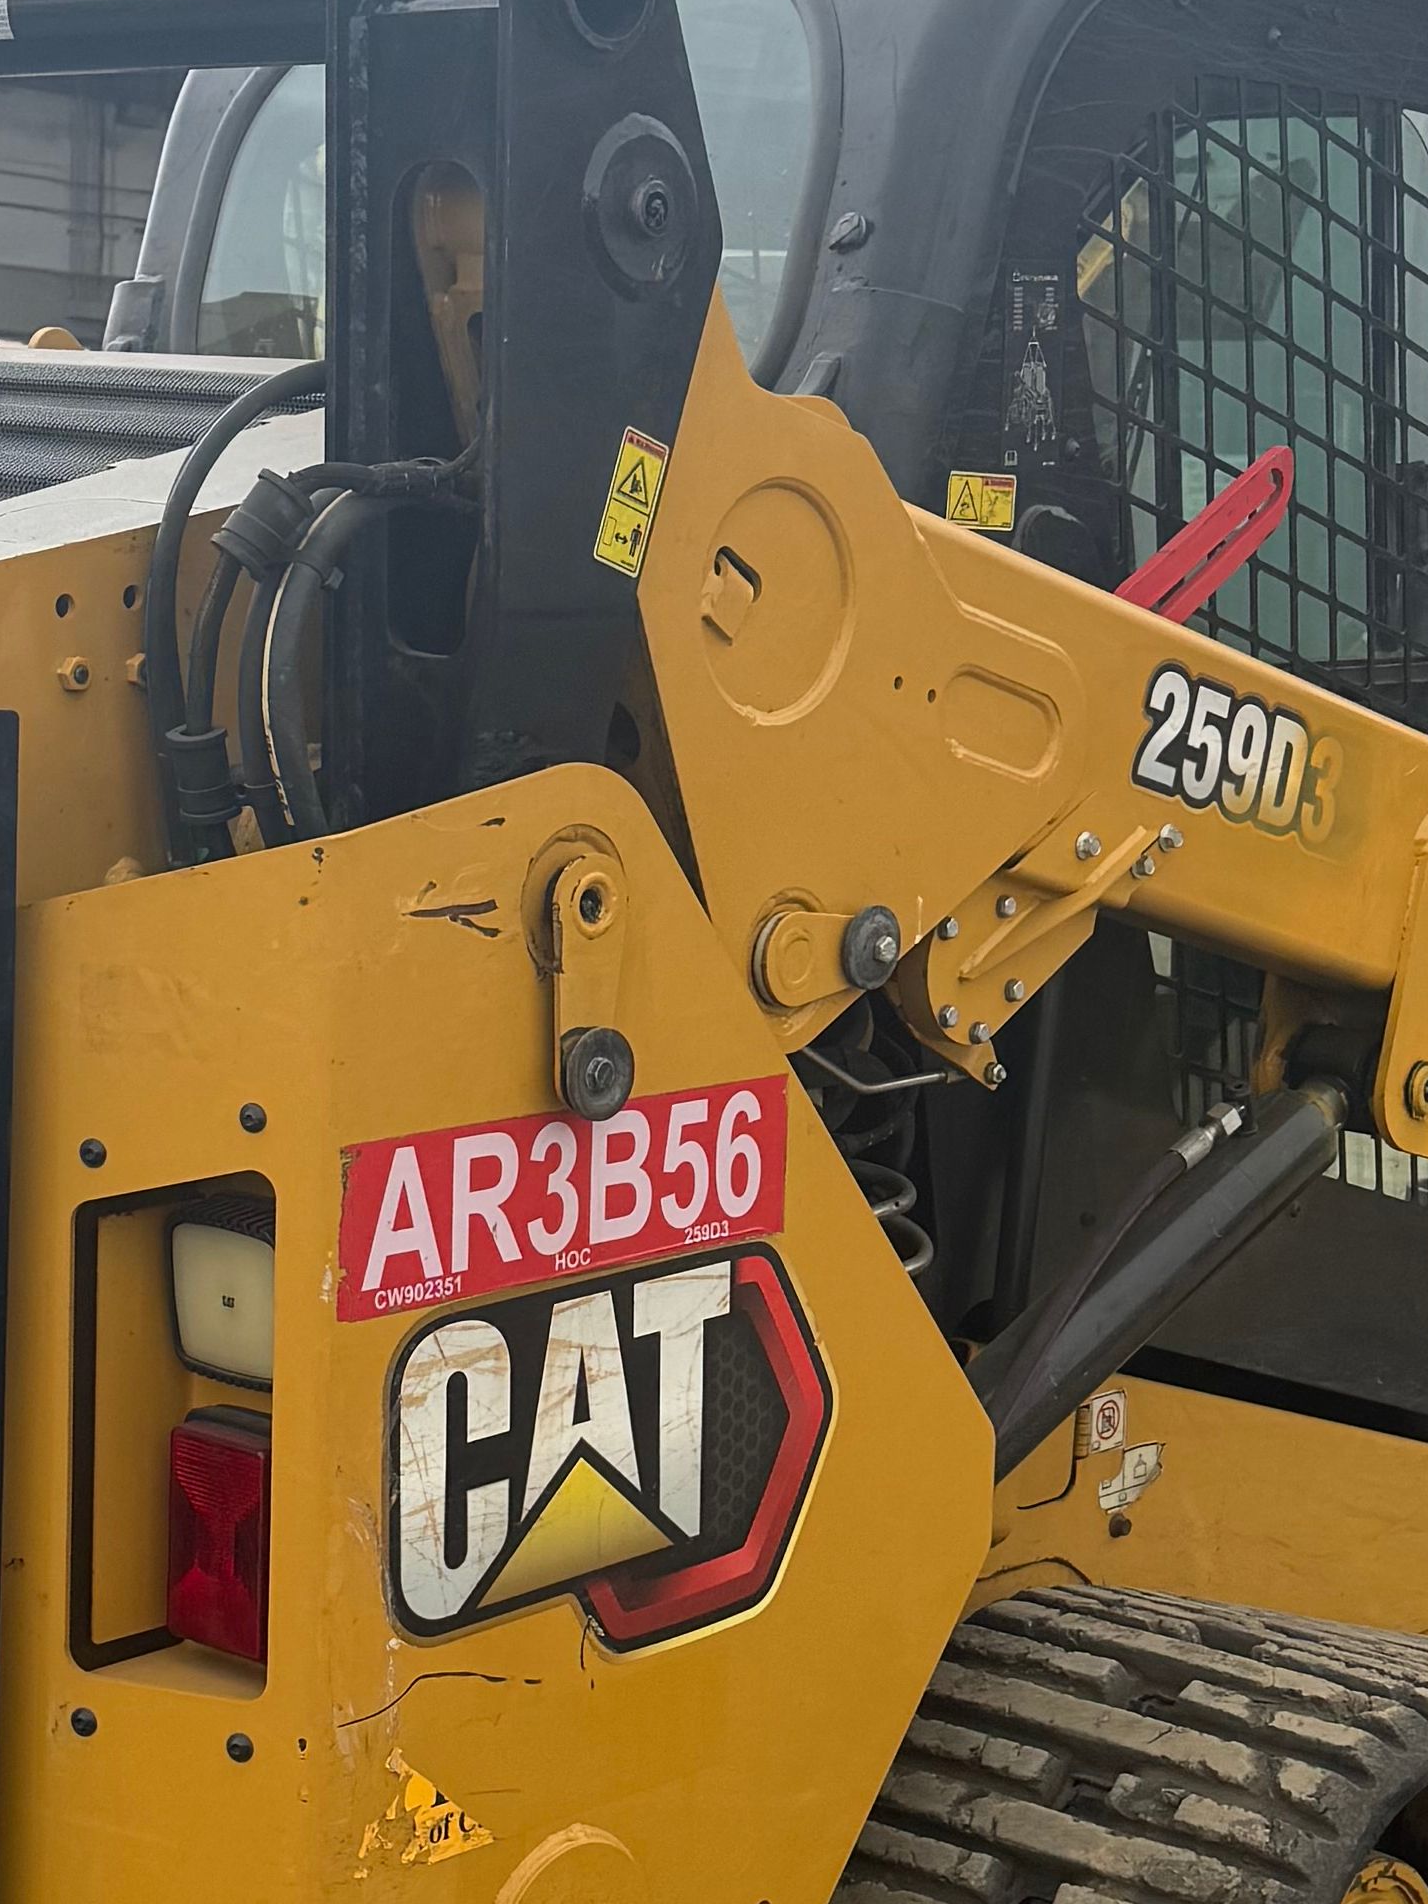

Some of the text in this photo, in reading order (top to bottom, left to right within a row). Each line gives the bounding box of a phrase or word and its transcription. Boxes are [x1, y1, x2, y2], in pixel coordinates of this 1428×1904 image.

[1136, 670, 1344, 844] 259D3
[361, 1090, 763, 1292] AR3B56
[375, 1219, 730, 1311] CW902351 HOC 259D3
[400, 1261, 731, 1621] CAT
[429, 1812, 453, 1844] of
